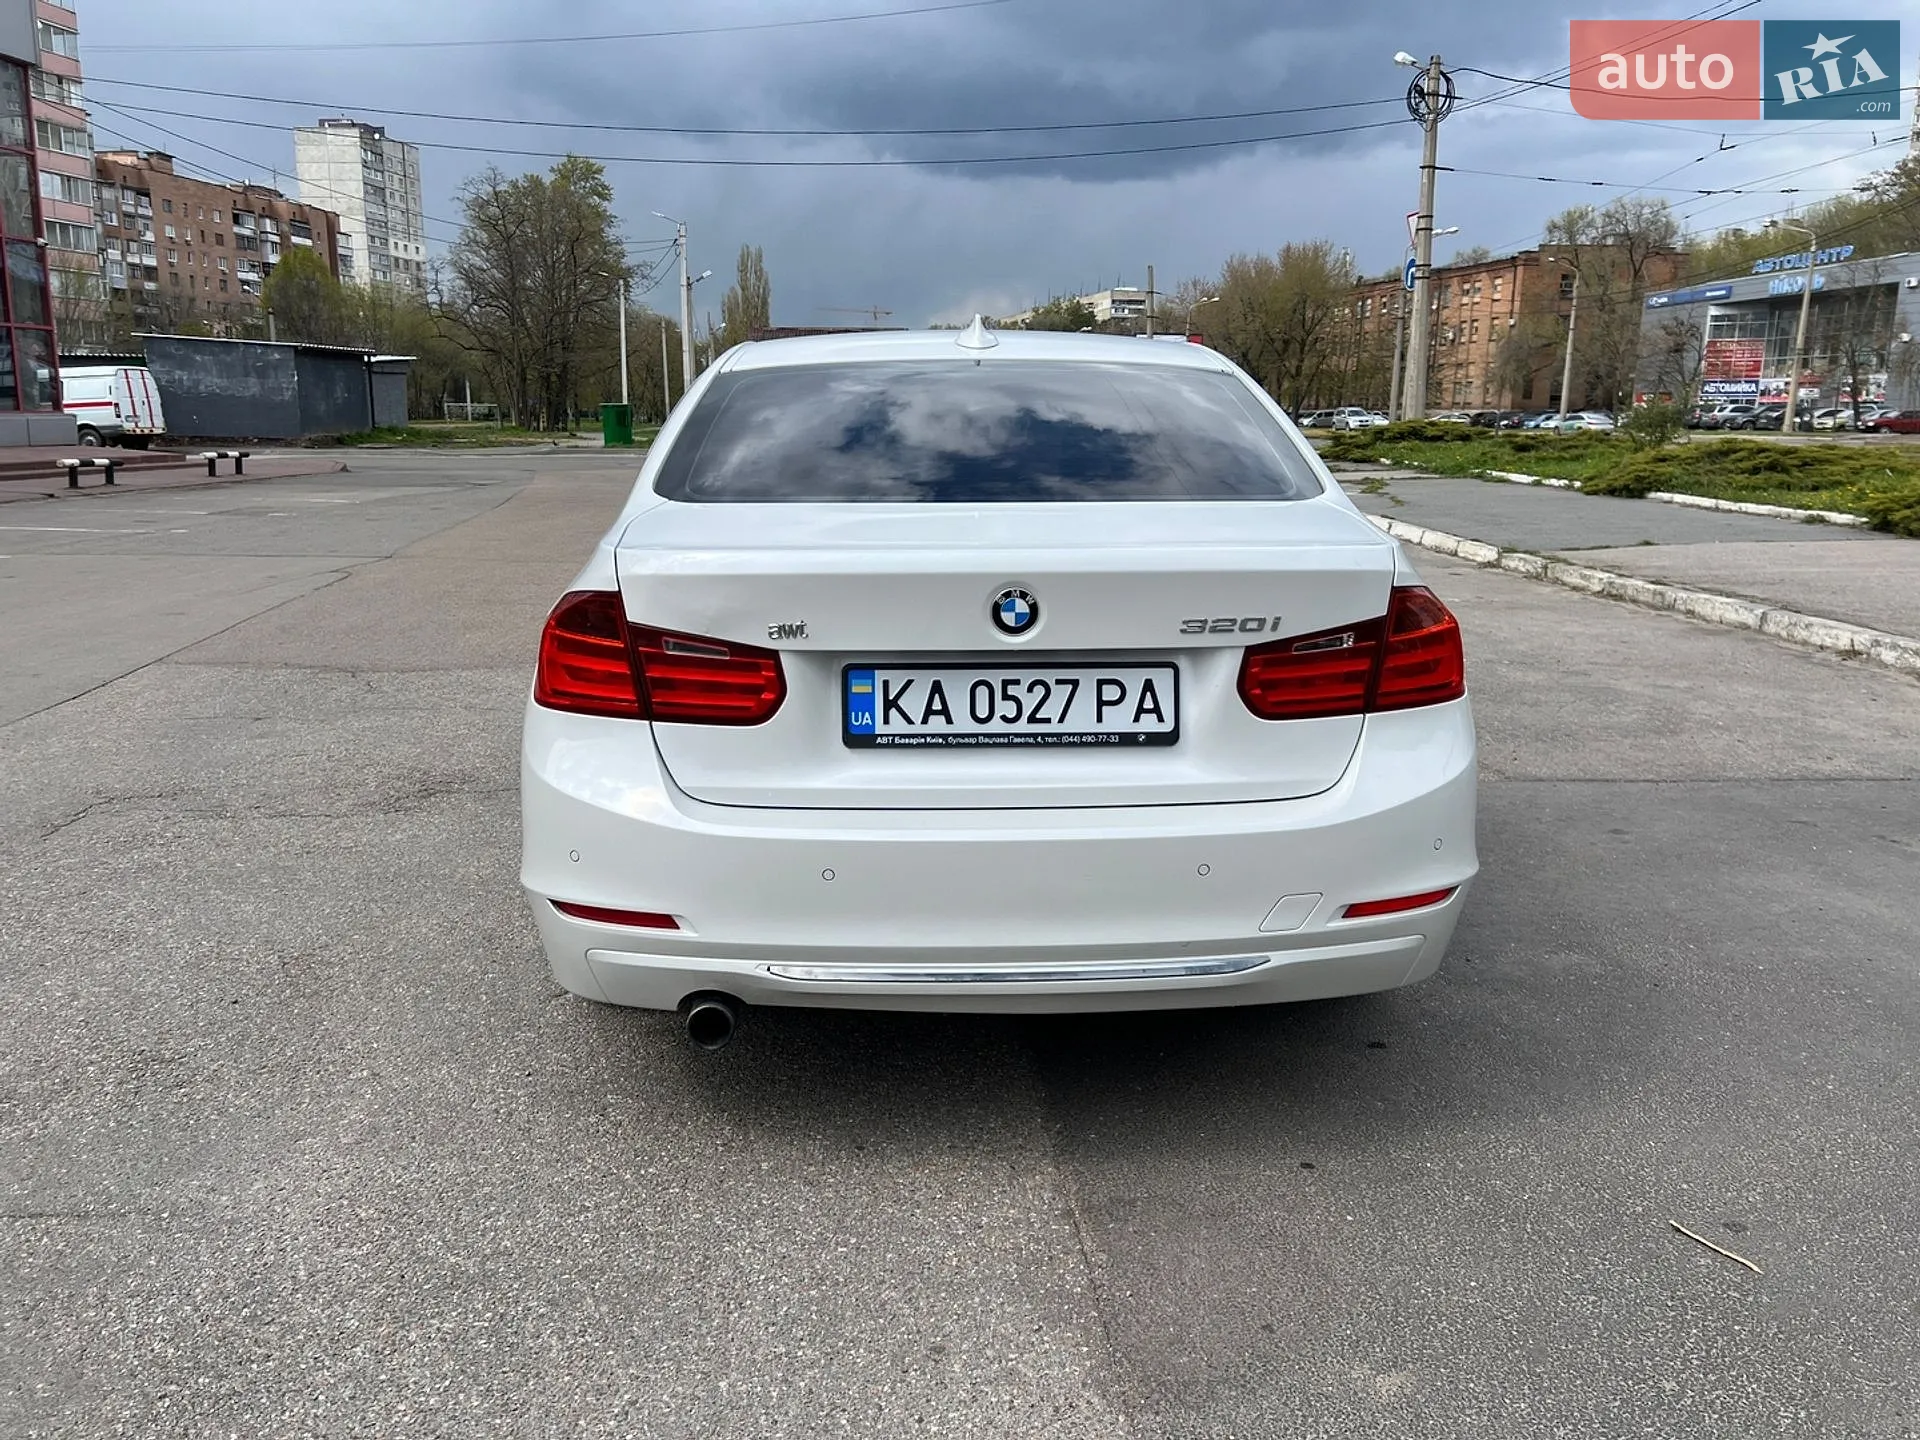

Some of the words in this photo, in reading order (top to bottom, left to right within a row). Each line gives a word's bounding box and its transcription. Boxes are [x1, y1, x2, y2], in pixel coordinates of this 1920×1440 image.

[1752, 245, 1854, 274] АВТОЦНТР
[996, 590, 1035, 605] BMW
[1179, 616, 1281, 634] 320i
[882, 679, 954, 725] KA
[969, 678, 1080, 725] 0527
[1096, 678, 1165, 724] PA
[851, 711, 873, 726] UA
[875, 735, 893, 744] АВТ
[1061, 734, 1080, 744] (044)
[1082, 734, 1119, 743] 490-77-33
